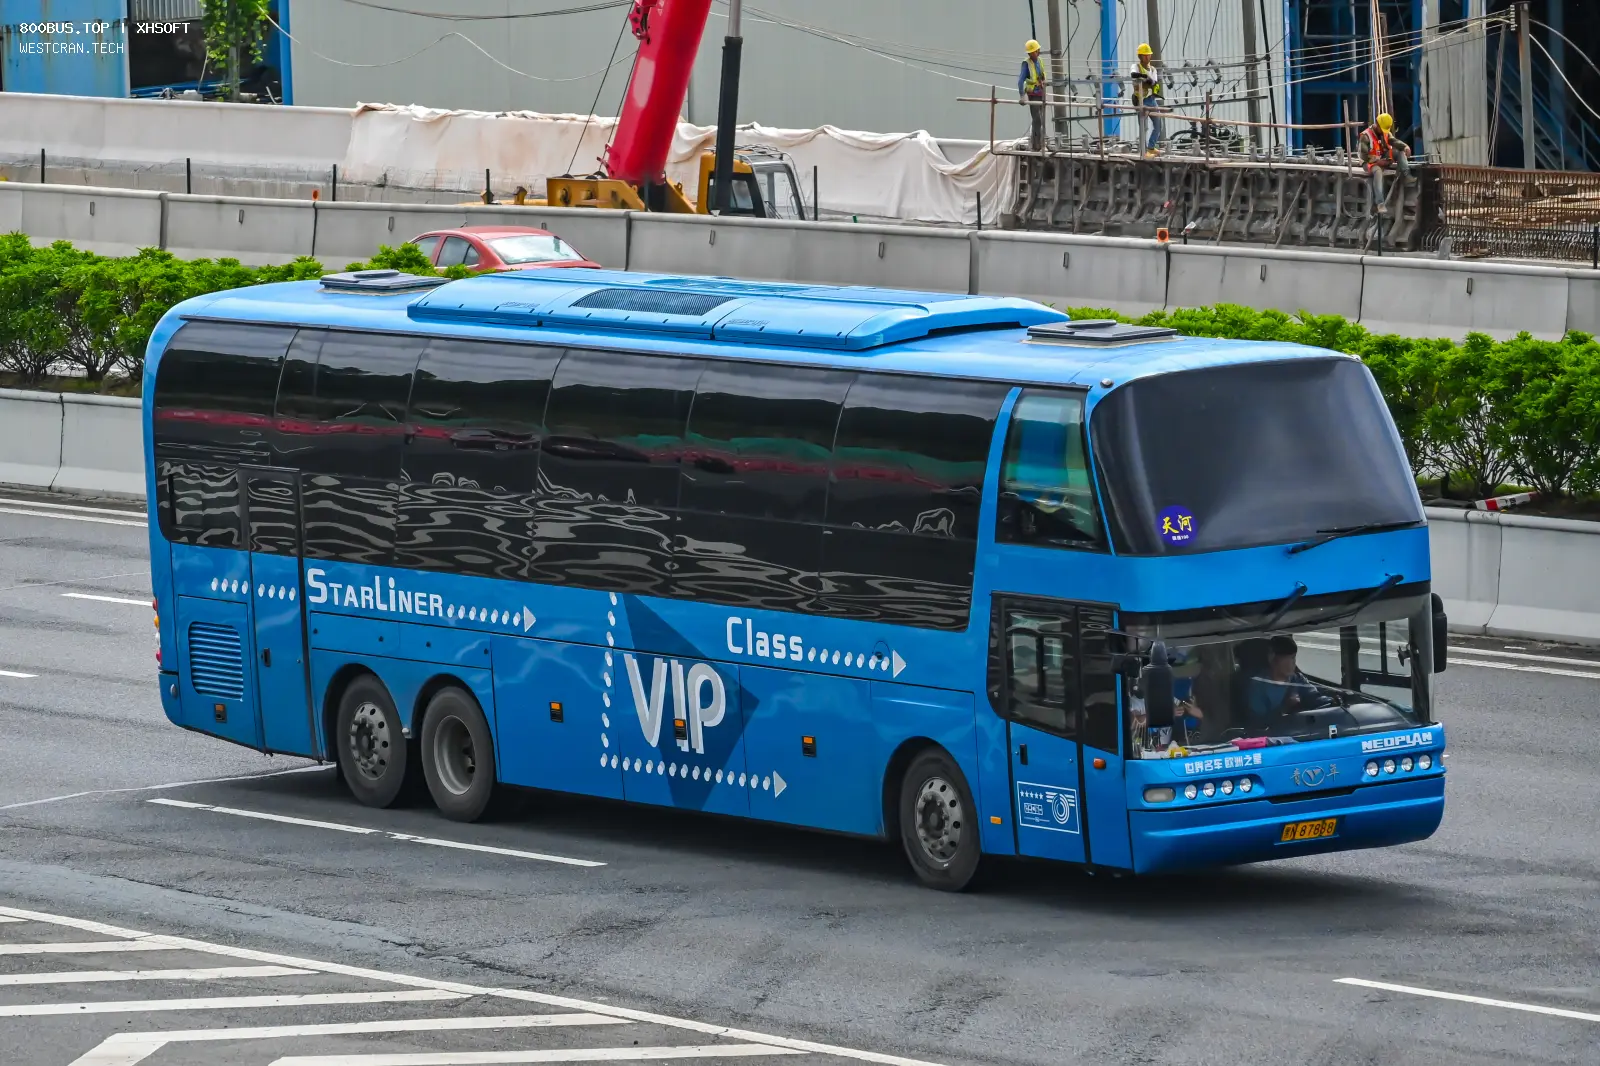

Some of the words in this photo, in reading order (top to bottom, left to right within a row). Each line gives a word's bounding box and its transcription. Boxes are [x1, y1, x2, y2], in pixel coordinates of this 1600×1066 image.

[1162, 514, 1192, 534] 天河
[726, 616, 803, 661] Class
[623, 653, 726, 754] VIP
[1361, 731, 1433, 752] NEOPLAN
